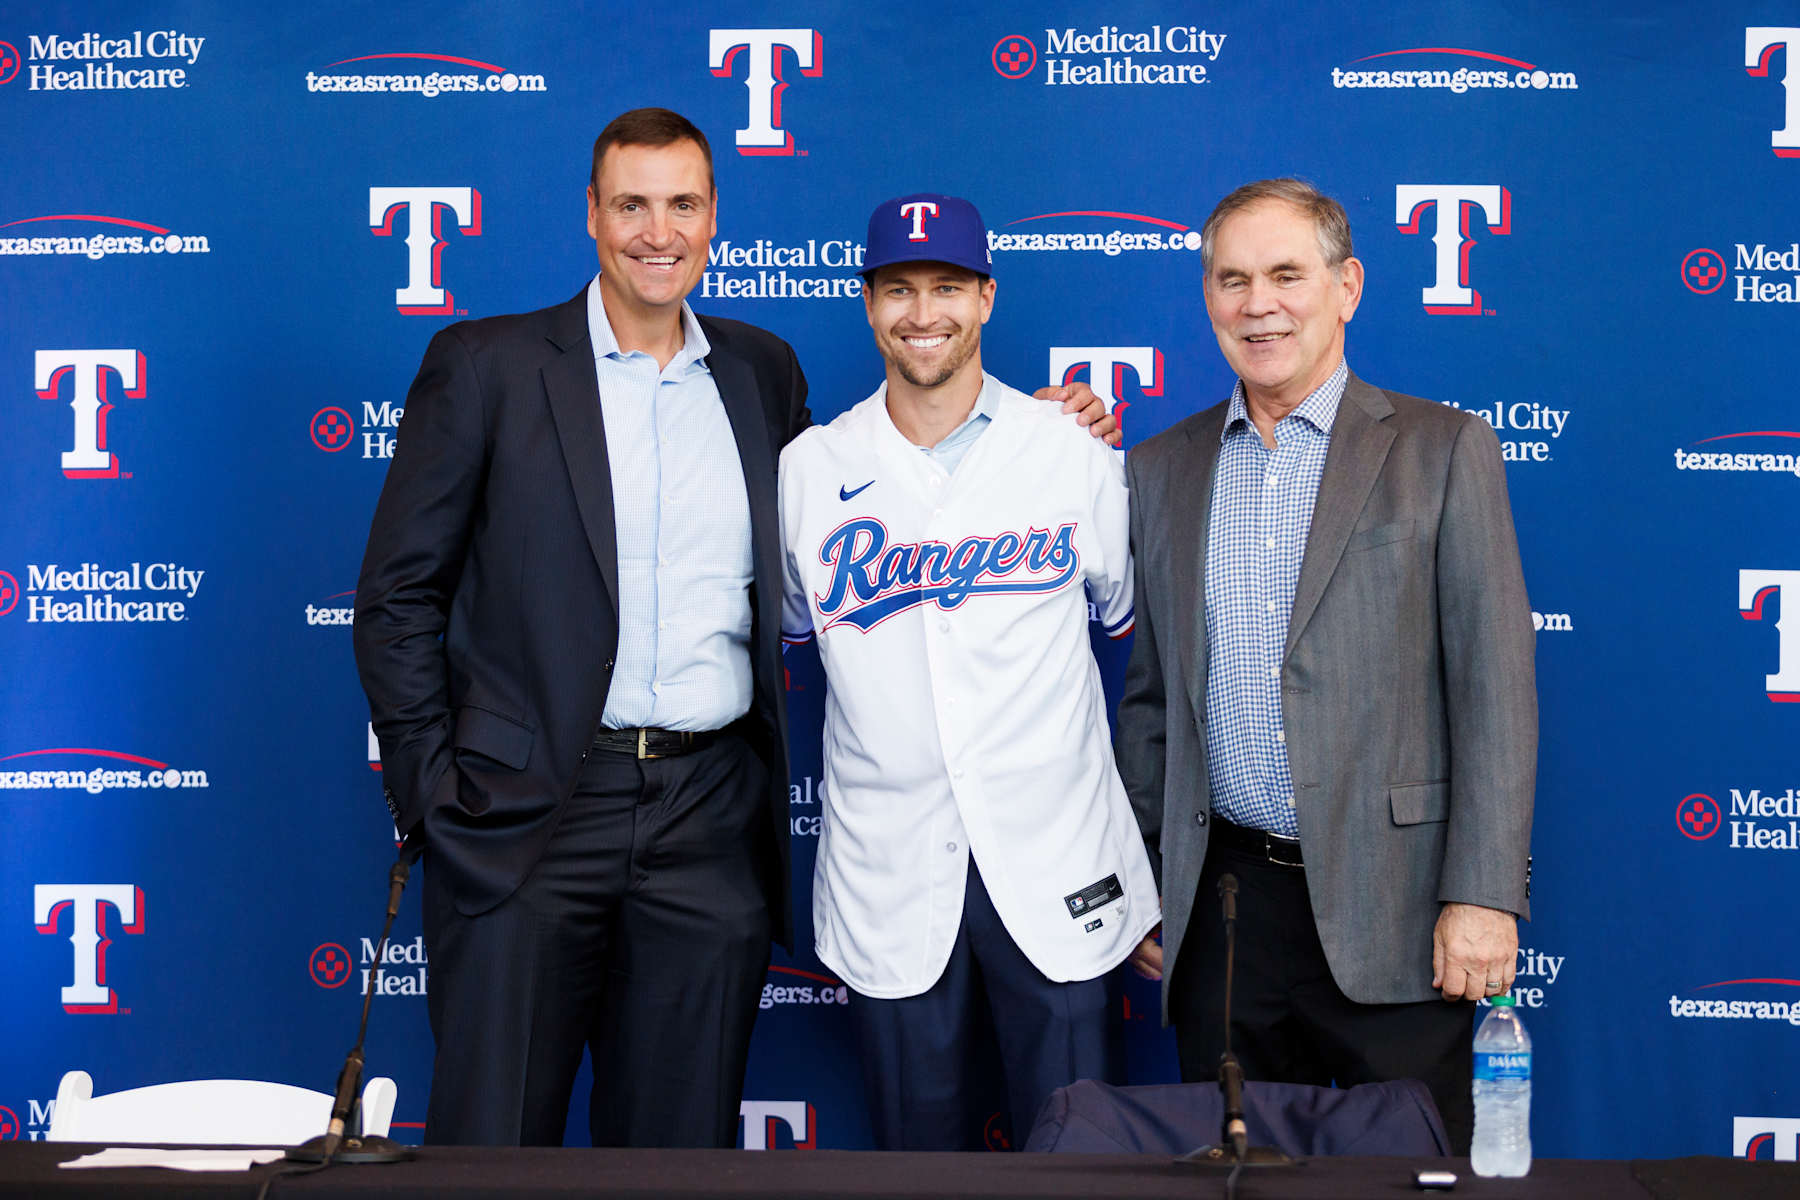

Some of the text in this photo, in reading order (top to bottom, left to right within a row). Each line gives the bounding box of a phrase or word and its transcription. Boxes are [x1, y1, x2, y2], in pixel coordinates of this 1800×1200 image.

[29, 31, 205, 64] Medical City
[1046, 26, 1227, 60] Medical City
[29, 63, 185, 90] Healthcare
[306, 72, 547, 97] texasrangers.com
[1045, 58, 1206, 86] Healthcare
[1331, 67, 1578, 93] texasrangers.com
[709, 29, 823, 156] T
[901, 202, 940, 242] T
[0, 234, 210, 259] xasrangers.com
[370, 187, 482, 315] T
[706, 239, 867, 268] Medical Cit
[986, 230, 1202, 258] texasrangers.co
[1396, 185, 1511, 315] T
[700, 270, 861, 298] Healthcare
[35, 349, 146, 479] T
[1509, 403, 1570, 438] City
[27, 563, 204, 597] Medical City
[816, 516, 1080, 622] Rangers
[27, 595, 184, 622] Healthcare
[0, 767, 209, 793] xasrangers.com
[34, 884, 145, 1014] T
[1515, 947, 1565, 985] City
[1669, 995, 1800, 1025] texasrang
